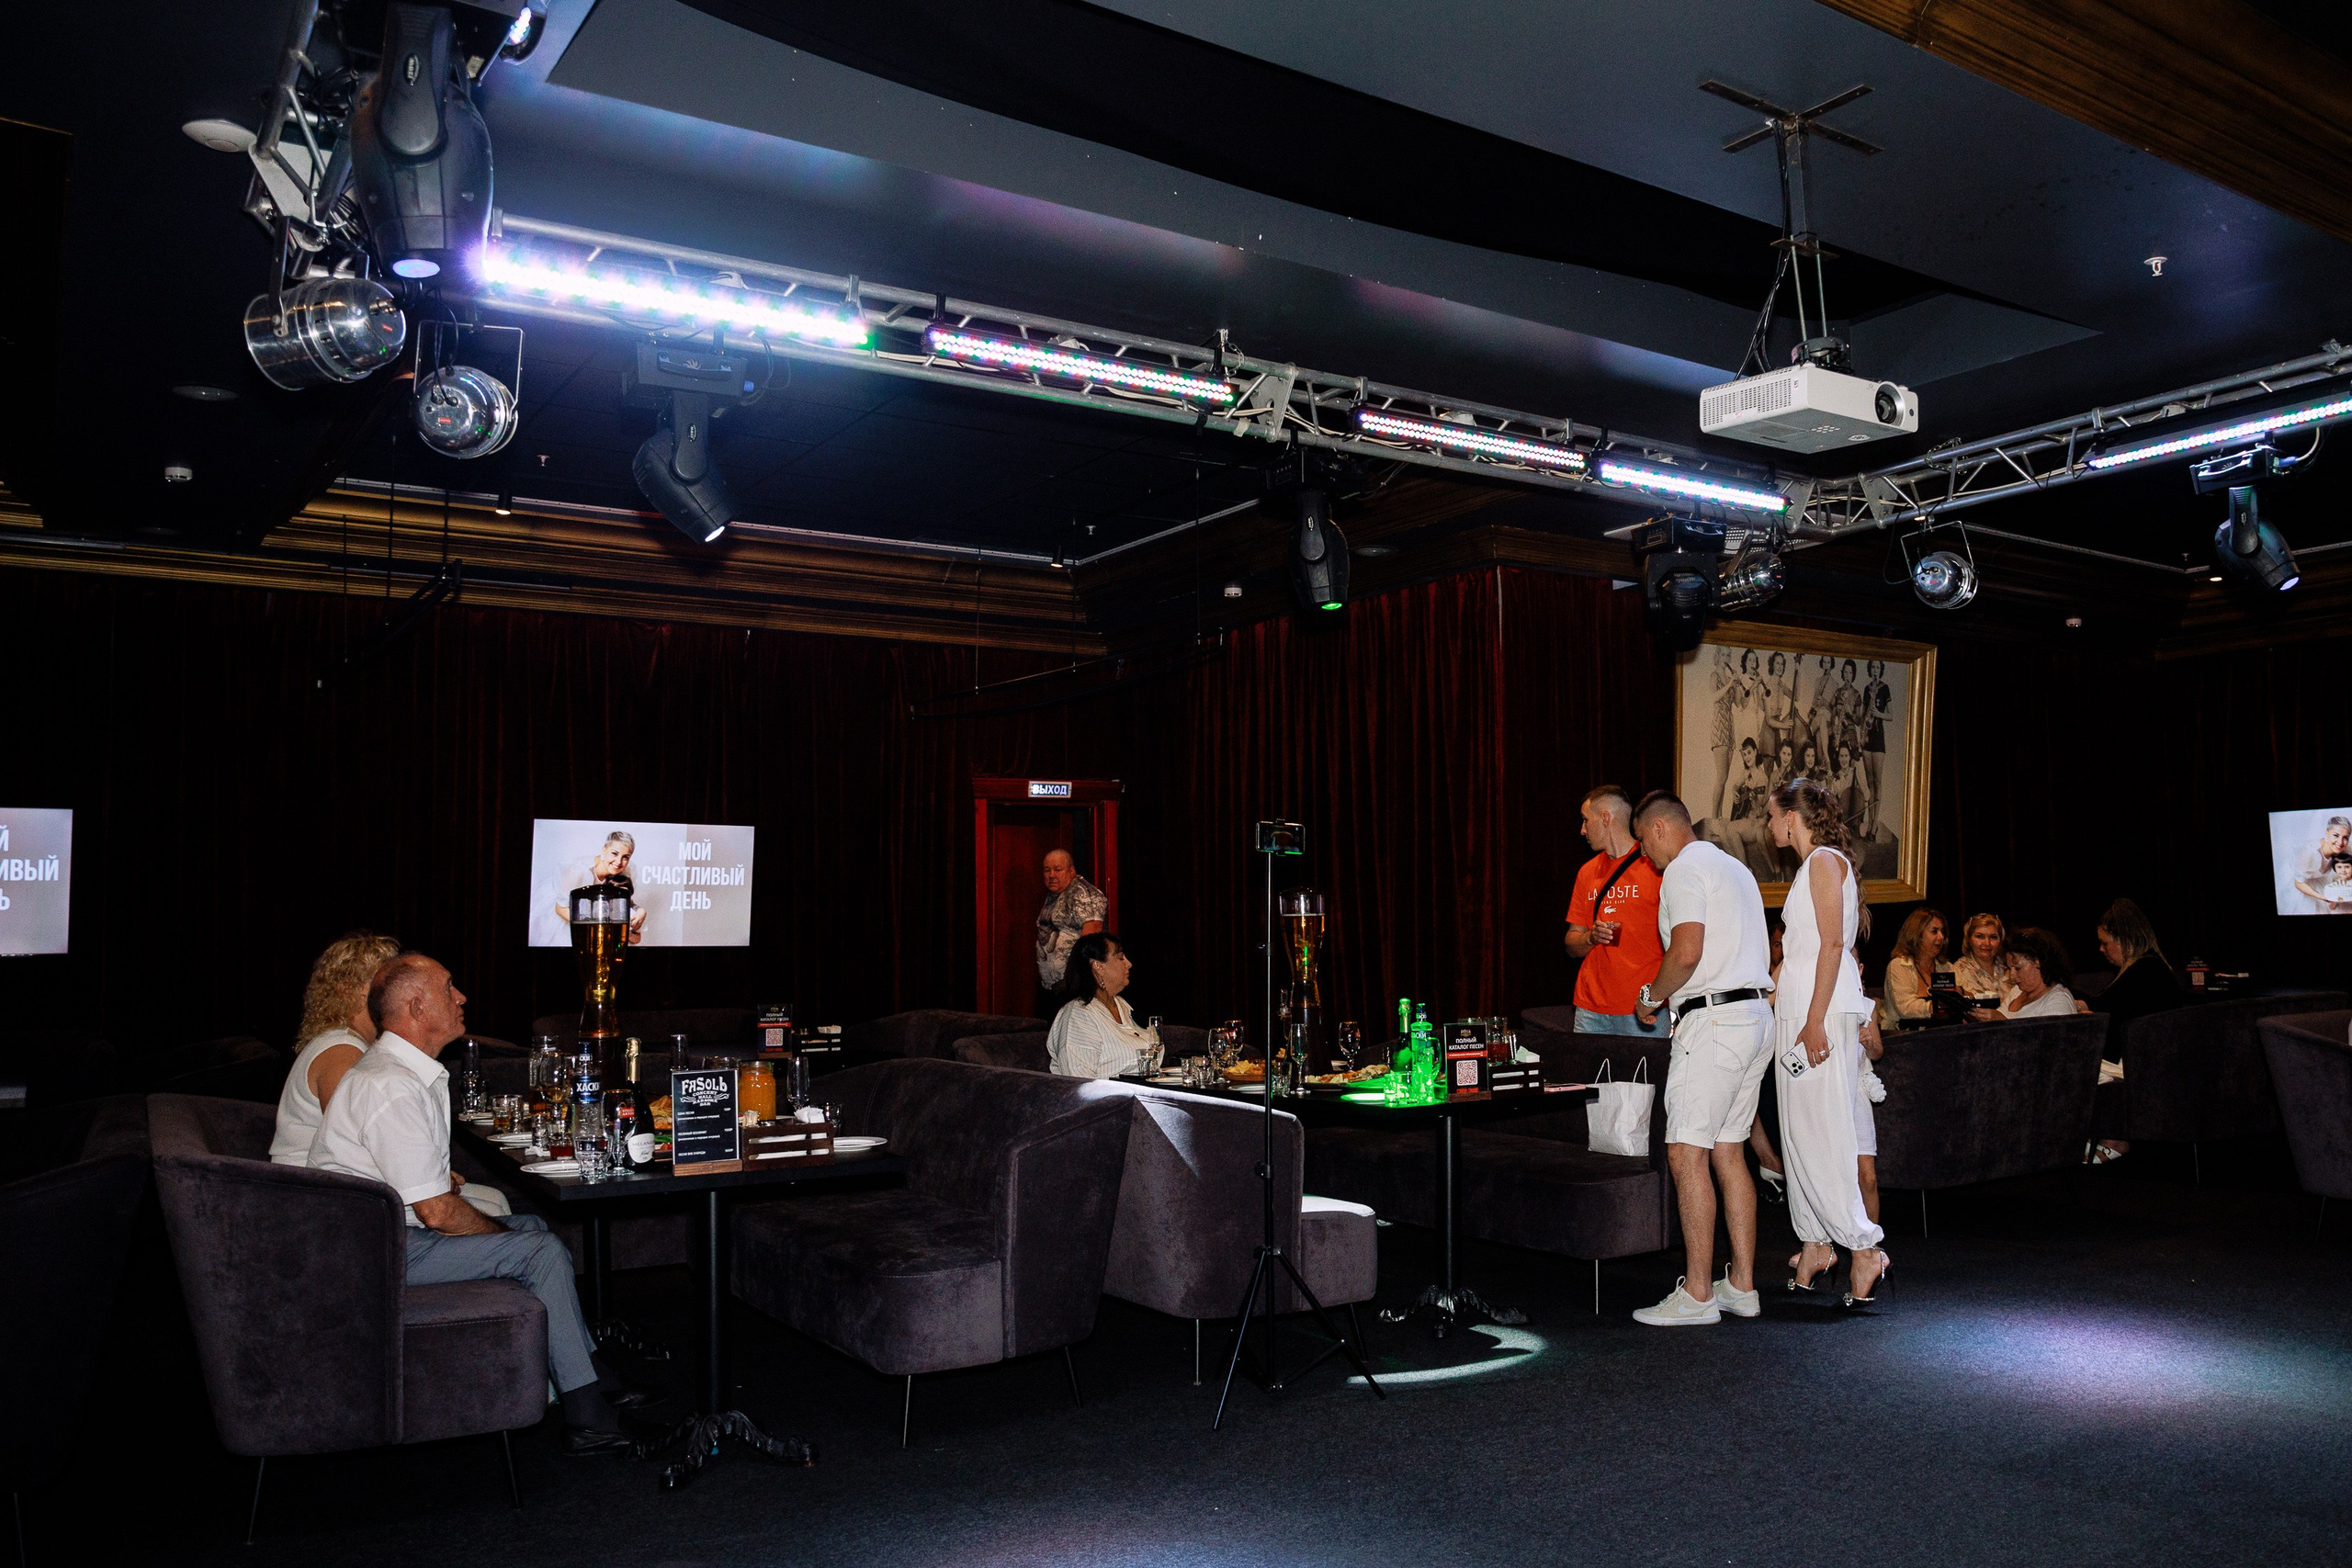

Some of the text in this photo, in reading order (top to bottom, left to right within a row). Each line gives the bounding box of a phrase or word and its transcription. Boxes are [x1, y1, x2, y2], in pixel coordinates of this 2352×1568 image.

[679, 838, 712, 861] МОЙ
[641, 863, 745, 886] СЧАСТЛИВЫЙ
[670, 890, 712, 911] ДЕНЬ
[1588, 885, 1639, 900] LAOSTE
